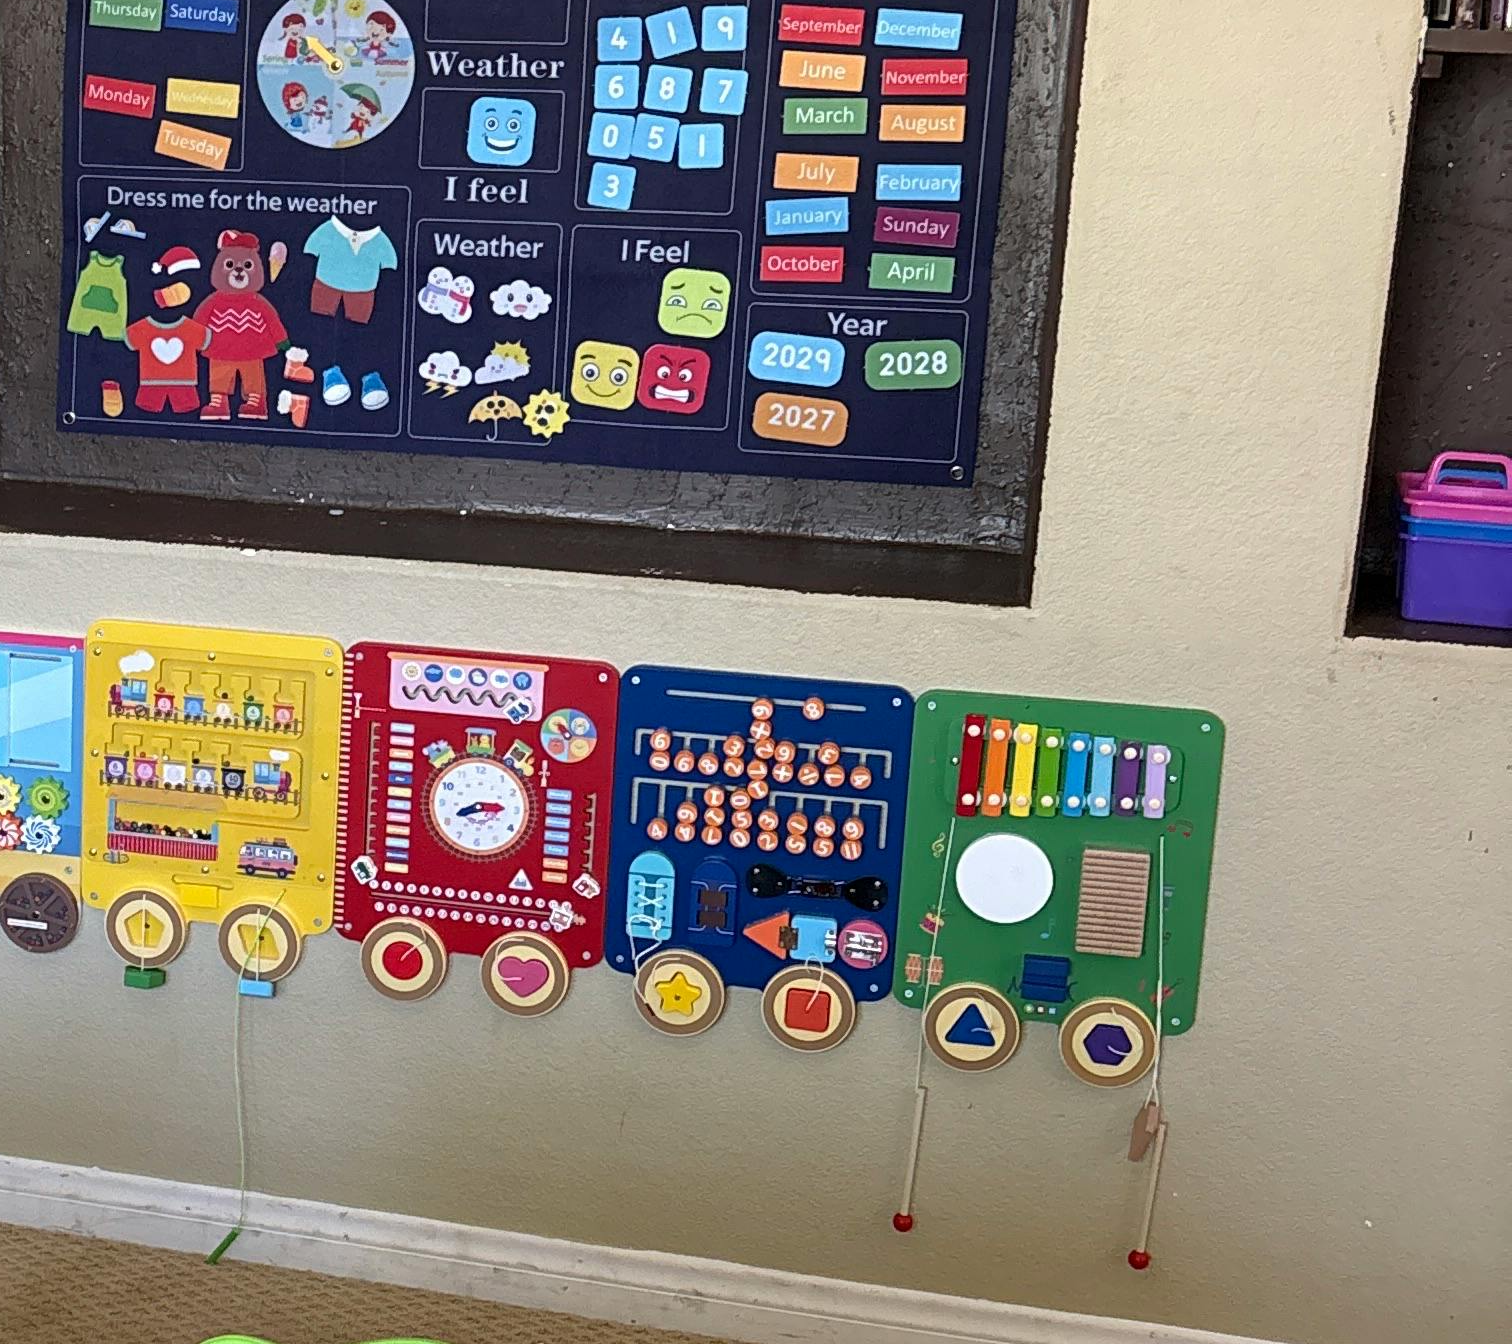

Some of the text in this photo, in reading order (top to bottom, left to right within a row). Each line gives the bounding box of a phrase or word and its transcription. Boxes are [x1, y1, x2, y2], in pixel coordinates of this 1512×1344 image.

[94, 0, 236, 25] Thursday Saturday
[610, 16, 734, 50] 4 1 9
[782, 16, 958, 39] September December
[427, 50, 565, 79] Weather
[799, 59, 966, 85] June November
[88, 83, 151, 110] Monday
[608, 75, 733, 103] 6 8 7
[795, 106, 957, 135] March August
[162, 132, 225, 159] Tuesday
[603, 124, 706, 157] 0 5 1
[444, 176, 528, 204] I feel
[604, 175, 620, 198] 3
[796, 162, 960, 193] July February
[107, 185, 377, 215] Dress me for the weather
[774, 209, 950, 239] January Sunday
[433, 233, 544, 258] Weather
[621, 239, 690, 263] I Feel
[767, 255, 935, 284] October April
[827, 312, 888, 337] Year
[761, 342, 948, 377] 2029 2028
[767, 403, 836, 432] 2027
[475, 766, 487, 775] 12
[443, 782, 454, 790] 10
[510, 788, 517, 797] 2
[506, 824, 514, 833] 4
